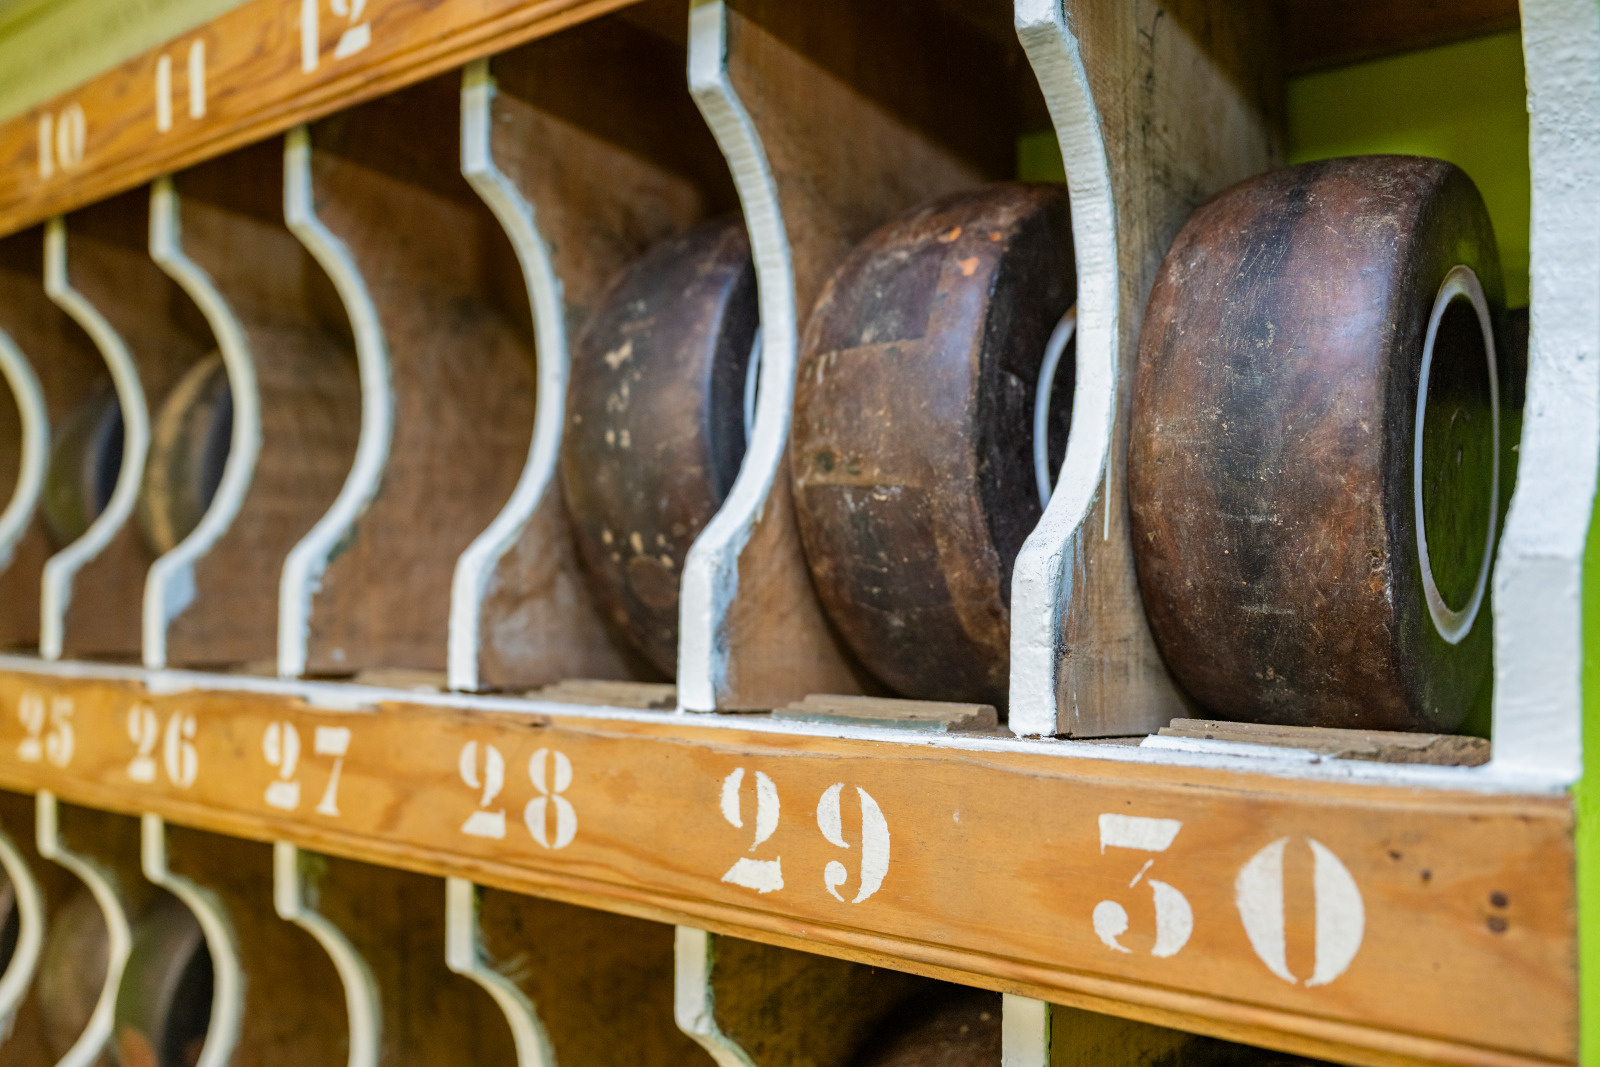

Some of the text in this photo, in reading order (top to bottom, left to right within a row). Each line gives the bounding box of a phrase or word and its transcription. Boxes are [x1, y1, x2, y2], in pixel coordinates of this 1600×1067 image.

[301, 0, 371, 73] 12
[157, 39, 207, 133] 11
[38, 103, 86, 180] 10
[17, 692, 75, 768] 25
[127, 702, 199, 790] 26
[262, 721, 351, 817] 27
[458, 740, 578, 850] 28
[720, 767, 891, 904] 29
[1092, 812, 1366, 988] 30
